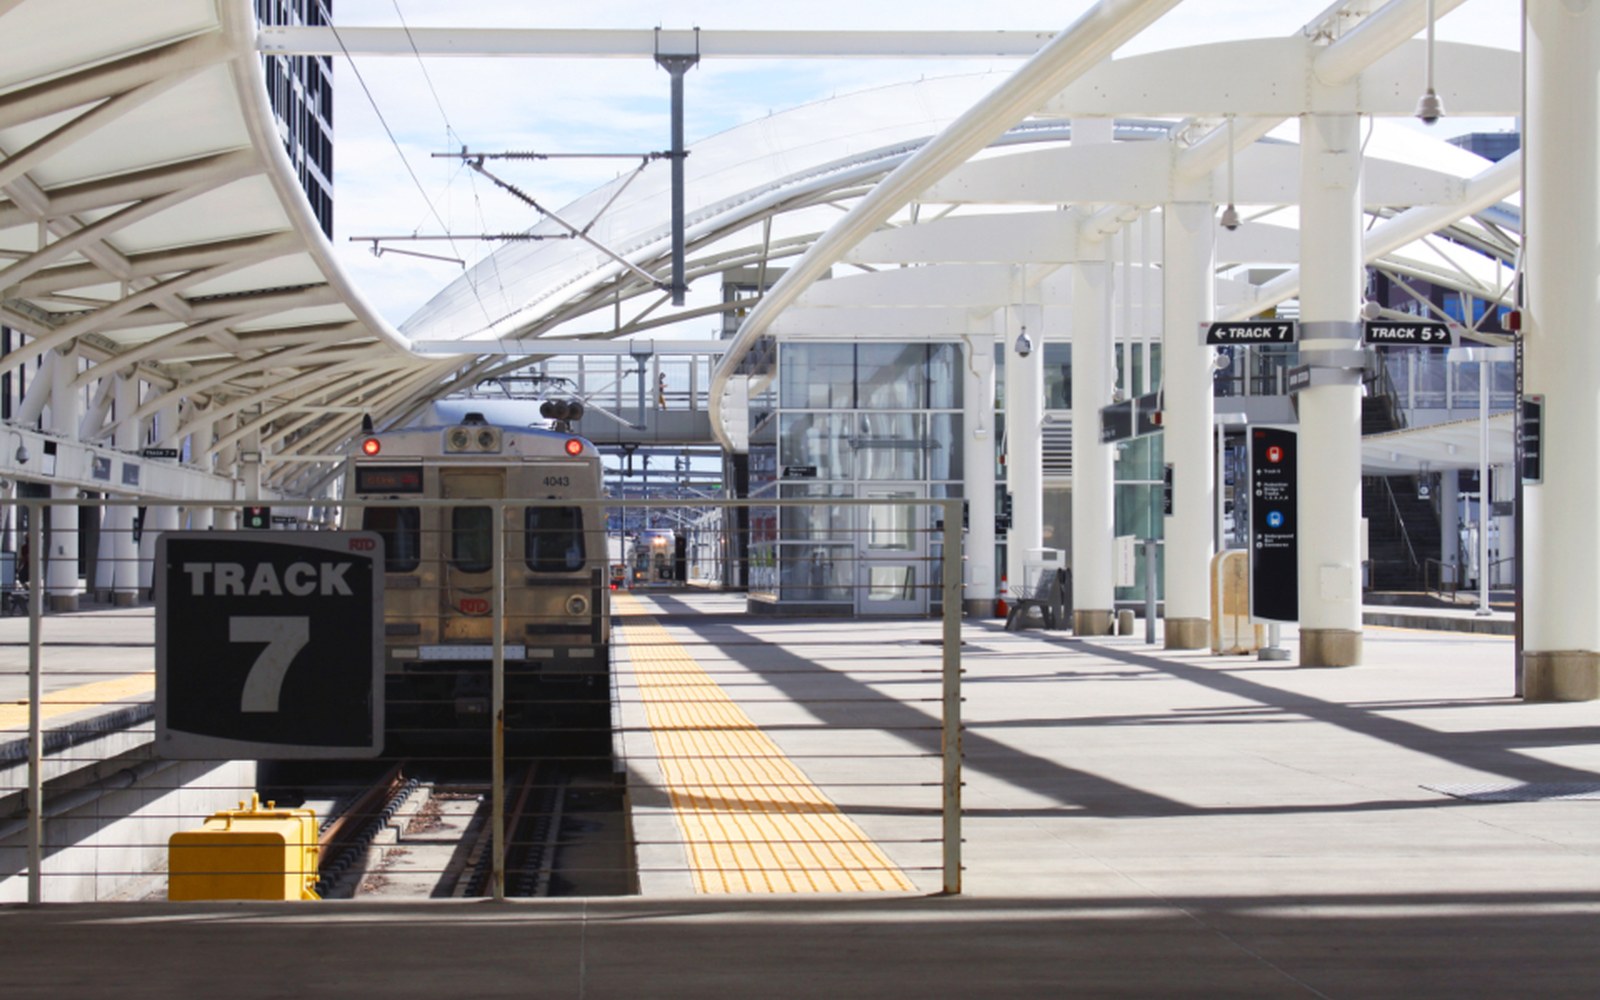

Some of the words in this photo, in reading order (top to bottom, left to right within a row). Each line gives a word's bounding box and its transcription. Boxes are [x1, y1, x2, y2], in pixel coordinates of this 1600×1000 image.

[1228, 327, 1272, 338] TRACK
[1278, 326, 1288, 339] 7
[1371, 327, 1416, 339] TRACK
[1421, 327, 1432, 341] 5
[543, 475, 570, 487] 4043
[348, 537, 377, 551] RTD
[183, 562, 354, 597] TRACK
[459, 598, 489, 613] RTD
[229, 615, 310, 713] 7
